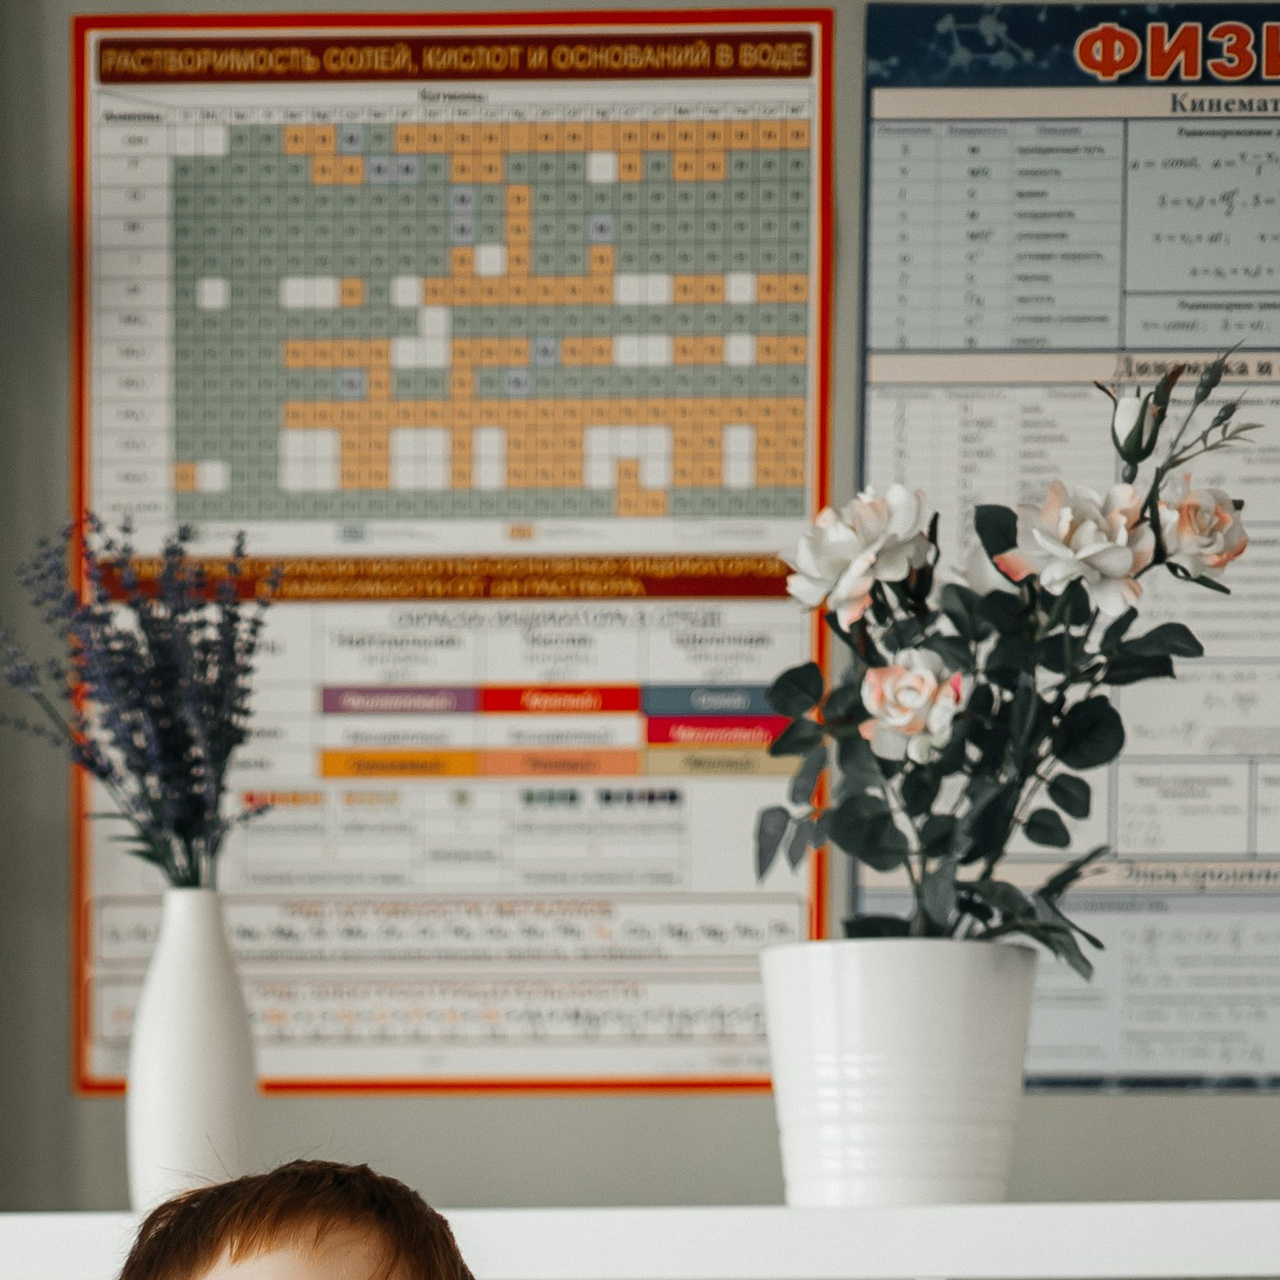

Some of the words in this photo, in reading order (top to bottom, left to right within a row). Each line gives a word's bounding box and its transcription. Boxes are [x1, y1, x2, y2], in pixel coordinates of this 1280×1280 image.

[100, 47, 320, 75] РАСТВОРИМОСТЬ
[322, 42, 418, 73] СОЛЕЙ,
[422, 45, 521, 72] КИСЛОТ
[526, 45, 548, 70] И
[552, 39, 712, 71] ОСНОВАНИЙ
[715, 43, 734, 69] В
[738, 42, 807, 70] ВОДЕ
